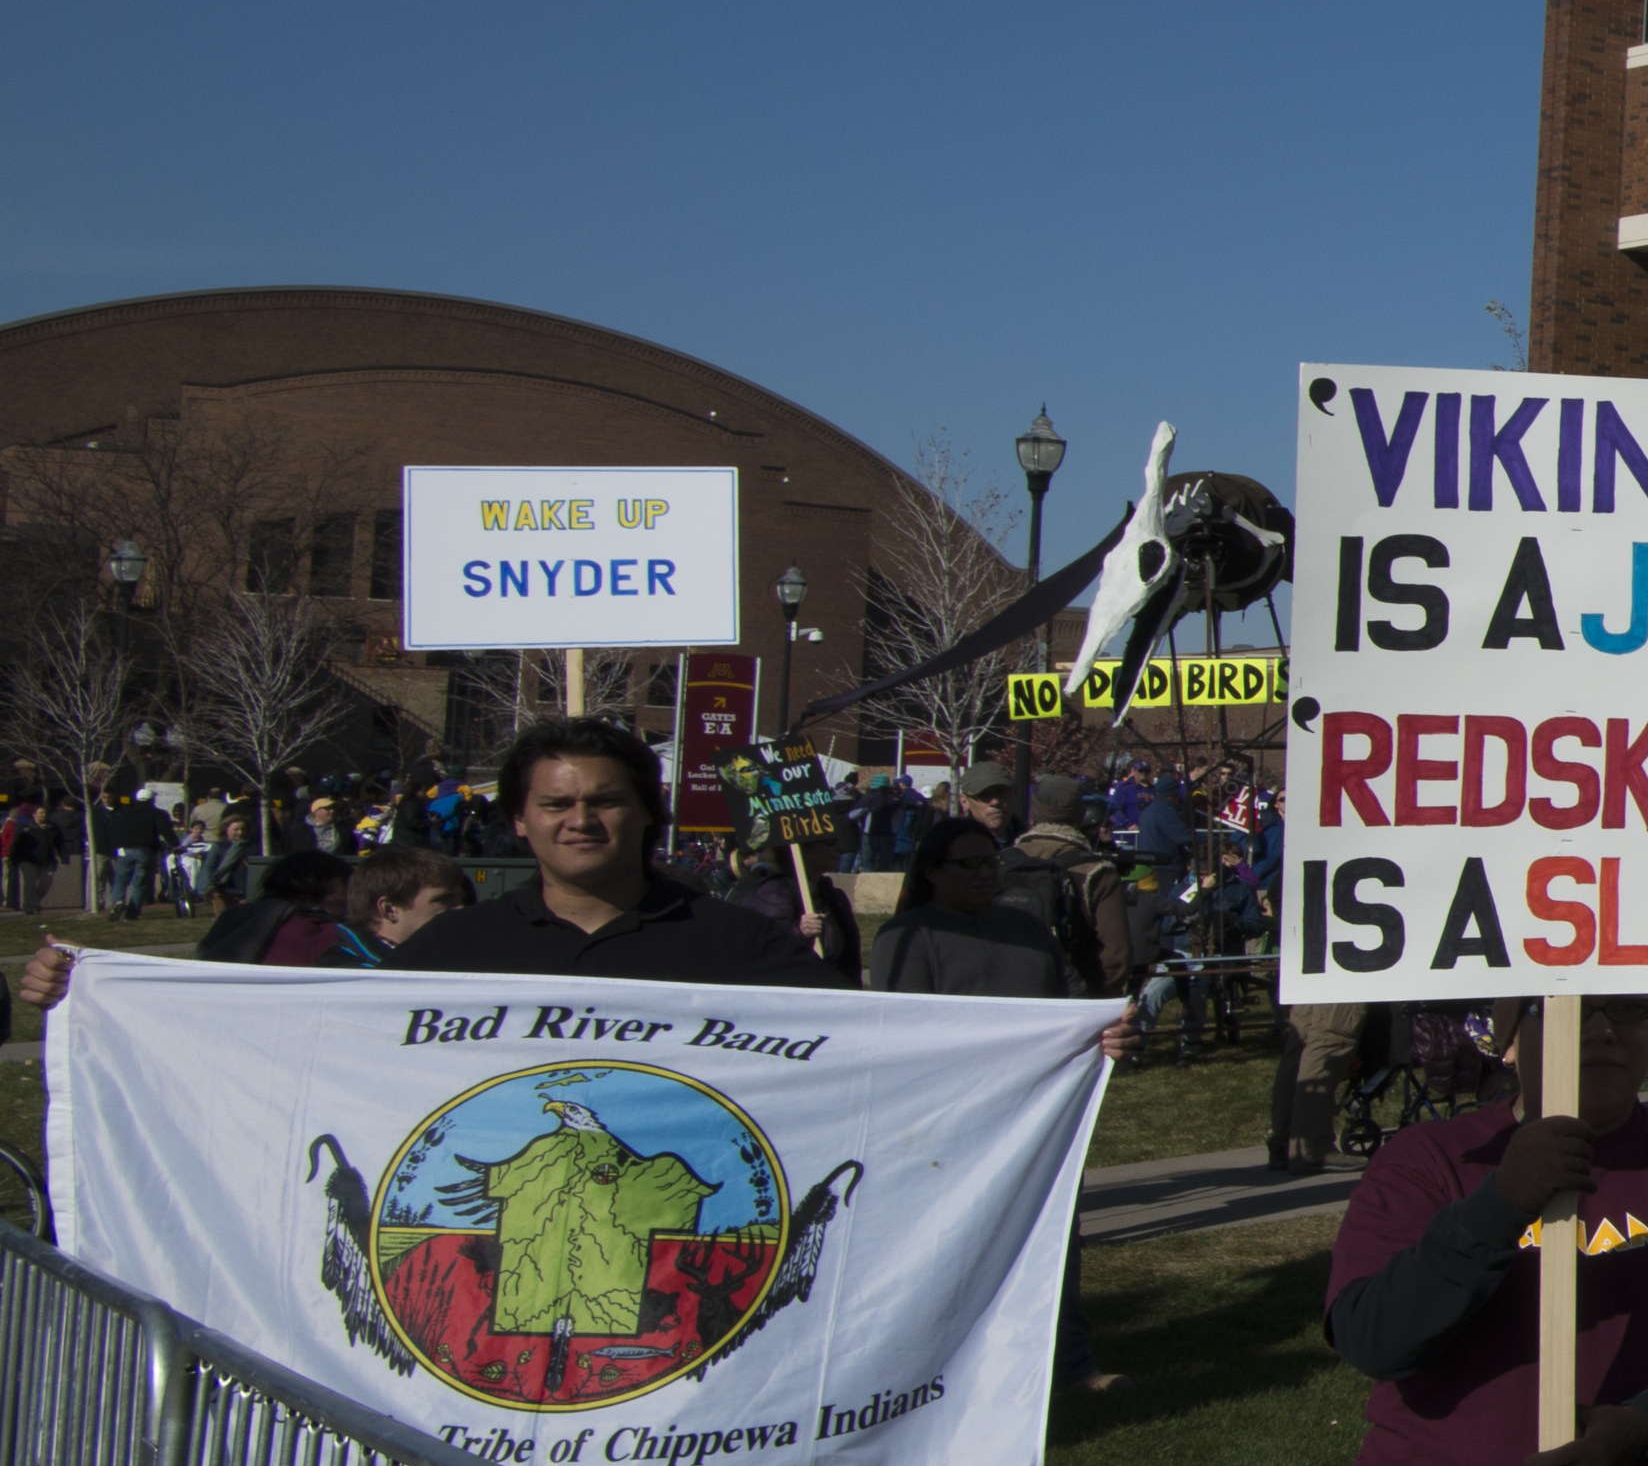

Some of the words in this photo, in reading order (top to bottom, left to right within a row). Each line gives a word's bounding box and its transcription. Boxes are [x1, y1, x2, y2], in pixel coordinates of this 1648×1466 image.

[480, 499, 595, 531] WAKE
[617, 498, 669, 530] UP
[462, 558, 677, 598] SNYDER
[1334, 535, 1451, 652] IS
[1481, 536, 1566, 651] A
[1013, 678, 1058, 717] NO
[701, 713, 736, 722] GATES
[700, 764, 716, 772] Gol
[760, 743, 783, 764] We
[785, 737, 815, 762] need
[780, 808, 835, 840] Birds
[1301, 856, 1405, 974] IS
[1430, 856, 1511, 970] A
[400, 1005, 508, 1046] Bad
[522, 1005, 673, 1043] River
[684, 1017, 829, 1061] Band
[437, 1424, 535, 1464] Tribe
[550, 1423, 590, 1464] of
[815, 1372, 946, 1441] Indians
